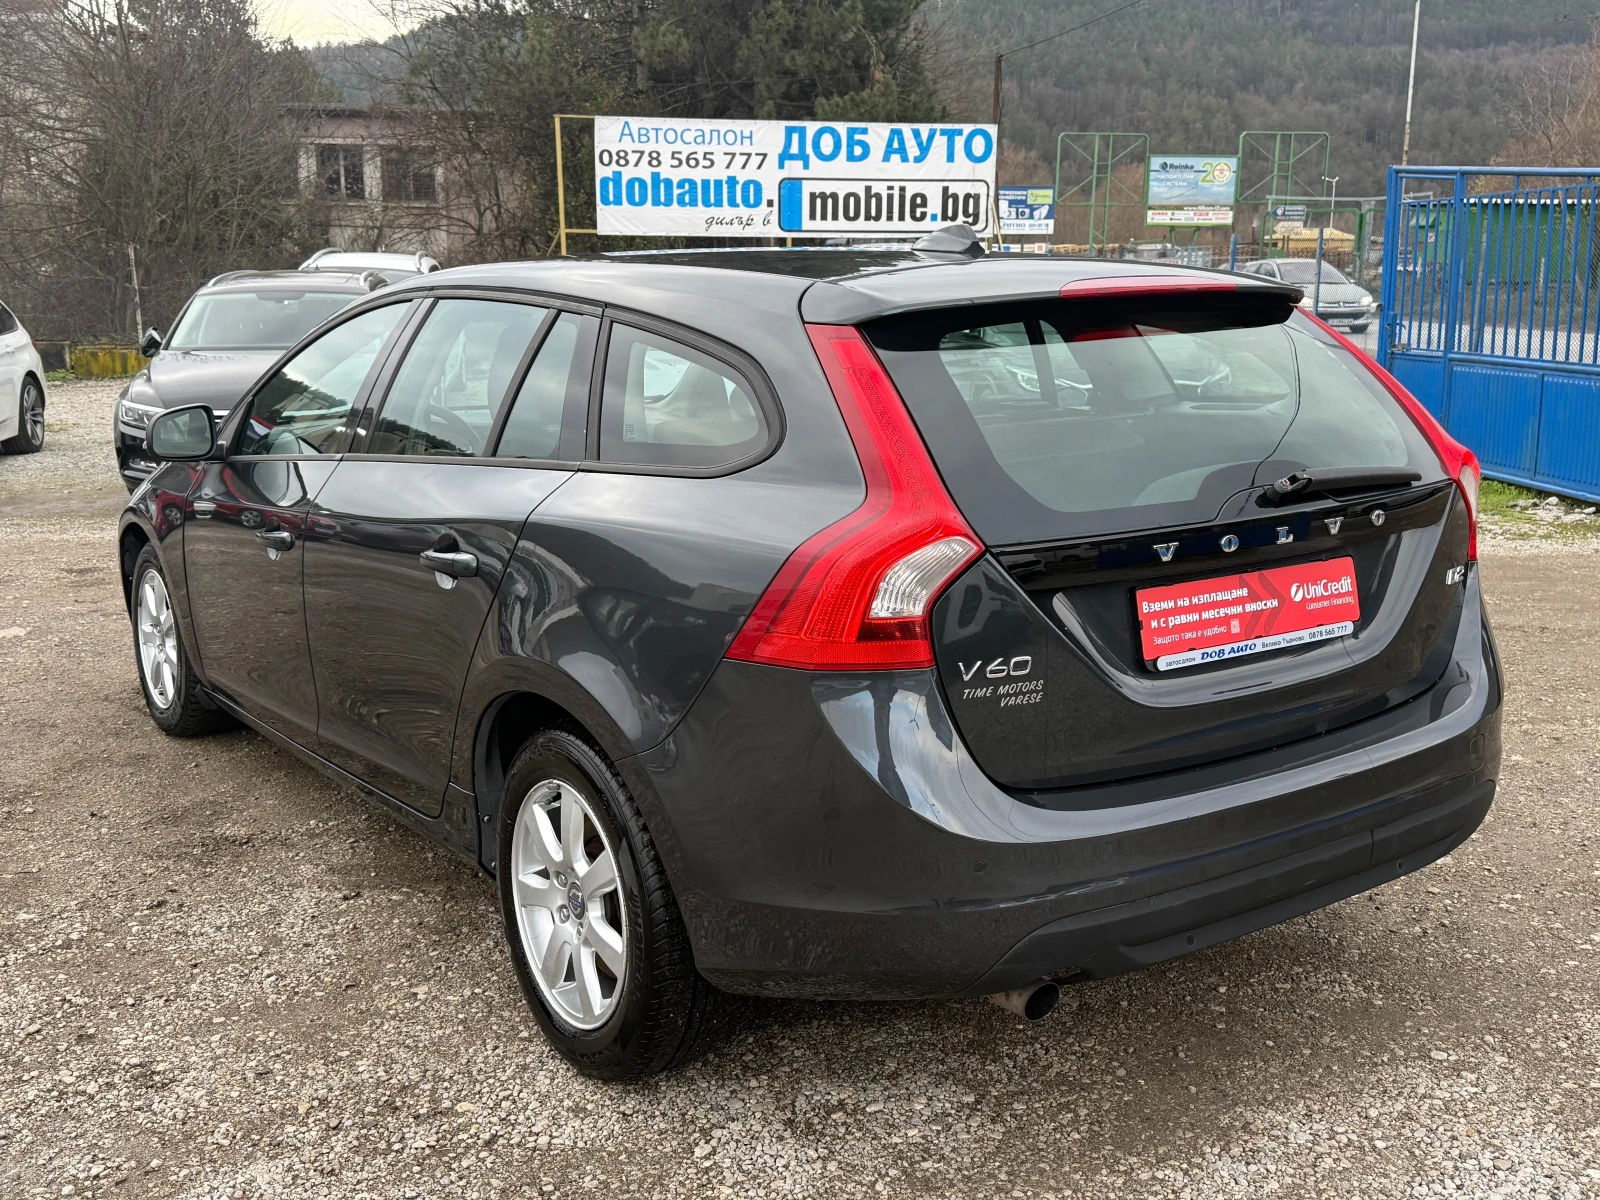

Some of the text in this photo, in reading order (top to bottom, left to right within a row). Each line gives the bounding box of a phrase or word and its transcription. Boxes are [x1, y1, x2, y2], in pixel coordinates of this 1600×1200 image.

[618, 120, 754, 146] Автосалон
[598, 148, 769, 170] 0878 565 777
[777, 125, 994, 170] ДОБ АУТО
[599, 170, 774, 209] dobauto.
[808, 185, 981, 226] mobile.bg
[704, 209, 773, 232] дилър в
[1152, 509, 1386, 562] VOLVO
[1303, 576, 1353, 599] UniCredit
[1142, 587, 1249, 614] Вземи на изплащане
[1306, 598, 1331, 611] Consumer
[1150, 598, 1279, 629] и с равни месечни вноски
[1153, 625, 1228, 646] Защото така е удобно
[1308, 625, 1348, 640] 0878 565 777
[1261, 640, 1282, 649] Велико
[957, 655, 1032, 682] V60
[962, 679, 1044, 700] TIME MOTORS
[1000, 692, 1044, 708] VARESE
